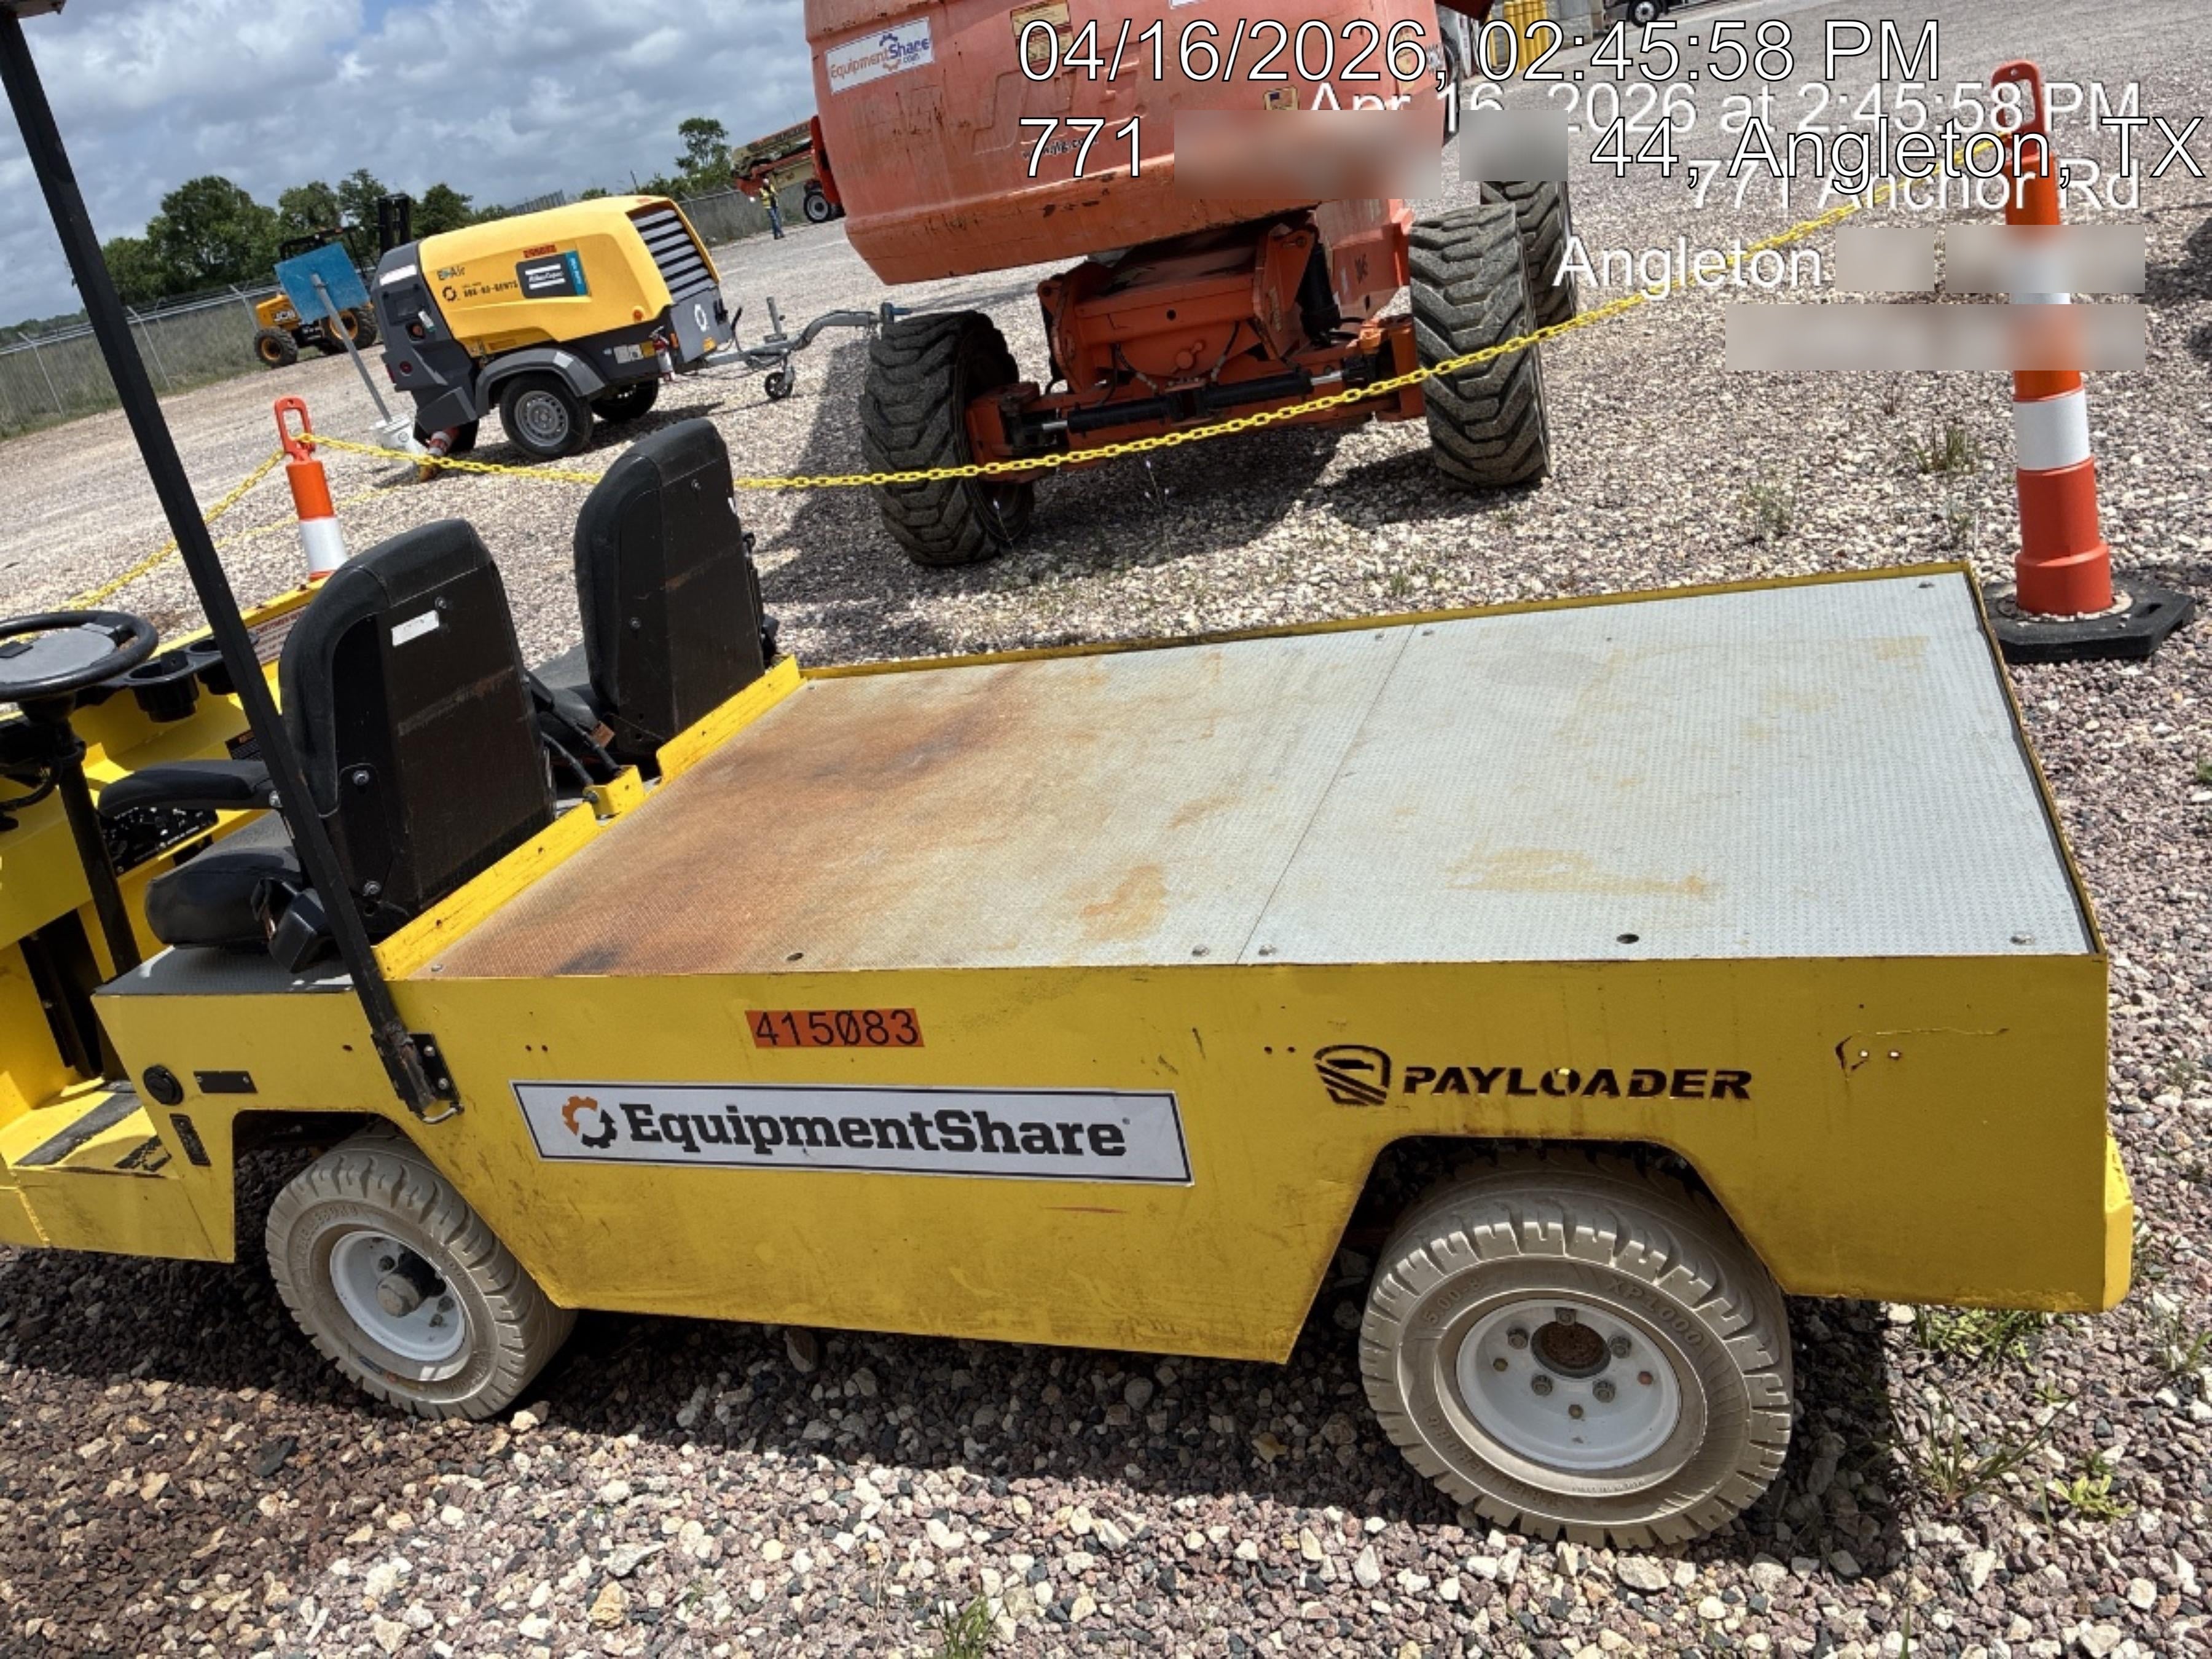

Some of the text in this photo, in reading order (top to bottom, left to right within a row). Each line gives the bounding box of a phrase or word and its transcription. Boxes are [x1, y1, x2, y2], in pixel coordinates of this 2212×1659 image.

[756, 1009, 919, 1046] 415083
[1403, 1066, 1752, 1100] PAYLOADER
[619, 1103, 1128, 1157] EquipmentShare
